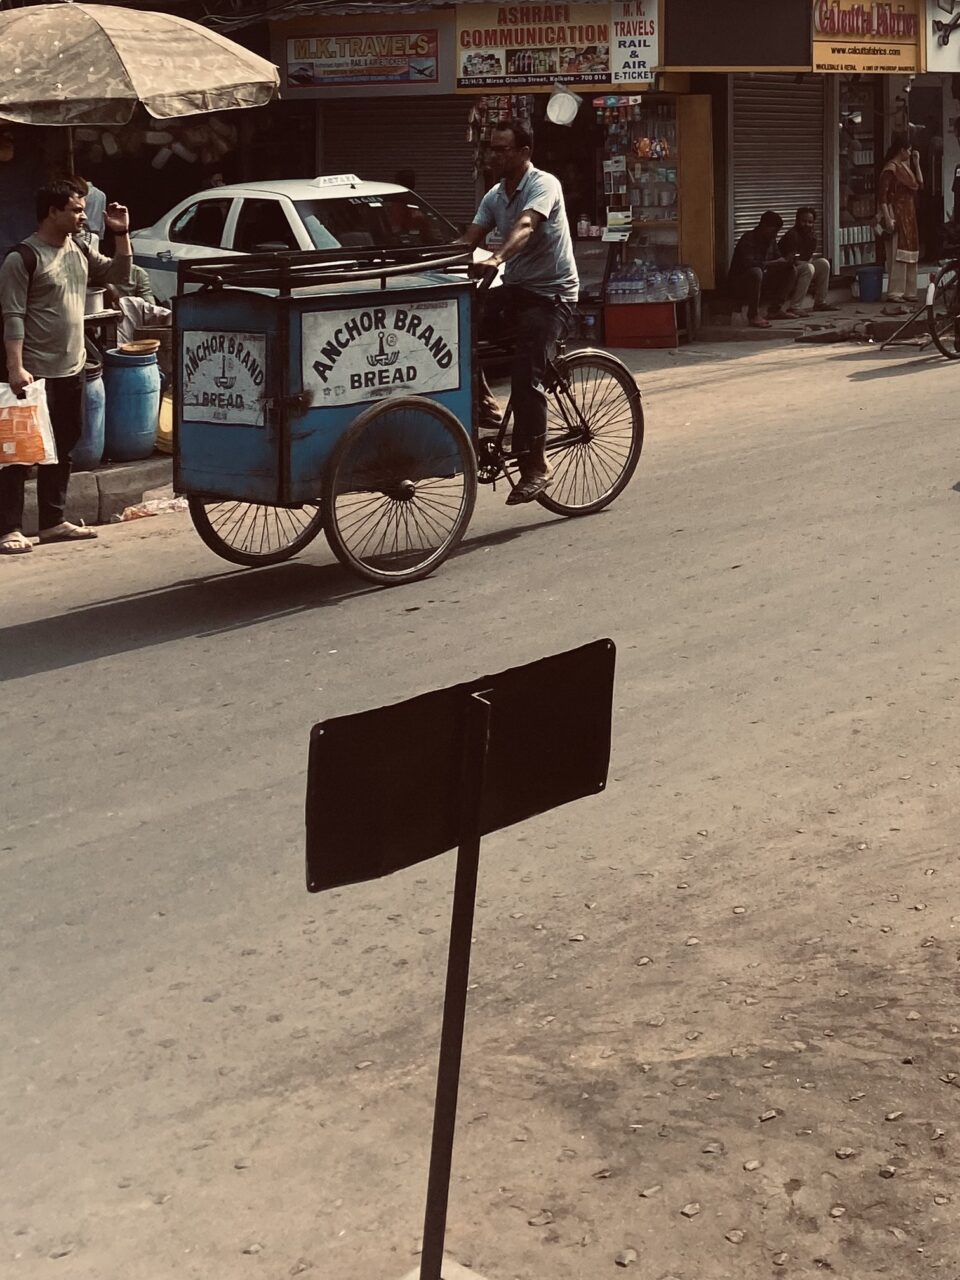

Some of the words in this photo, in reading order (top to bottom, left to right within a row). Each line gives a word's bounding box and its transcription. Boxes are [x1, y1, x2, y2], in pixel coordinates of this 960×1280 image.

[497, 4, 571, 26] ASHRAFI
[460, 24, 610, 49] COMMUNICATION
[614, 19, 655, 38] TRAVELS
[617, 39, 651, 49] RAIL
[831, 46, 901, 56] www.calcuttafabrics.com
[629, 51, 639, 59] &
[622, 61, 647, 70] AIR
[312, 308, 387, 384] ANCHOR
[393, 309, 453, 370] BRAND
[185, 335, 225, 382] ANCHOR
[227, 336, 264, 386] BRAND
[350, 365, 417, 390] BREAD
[202, 391, 244, 410] BREAD
